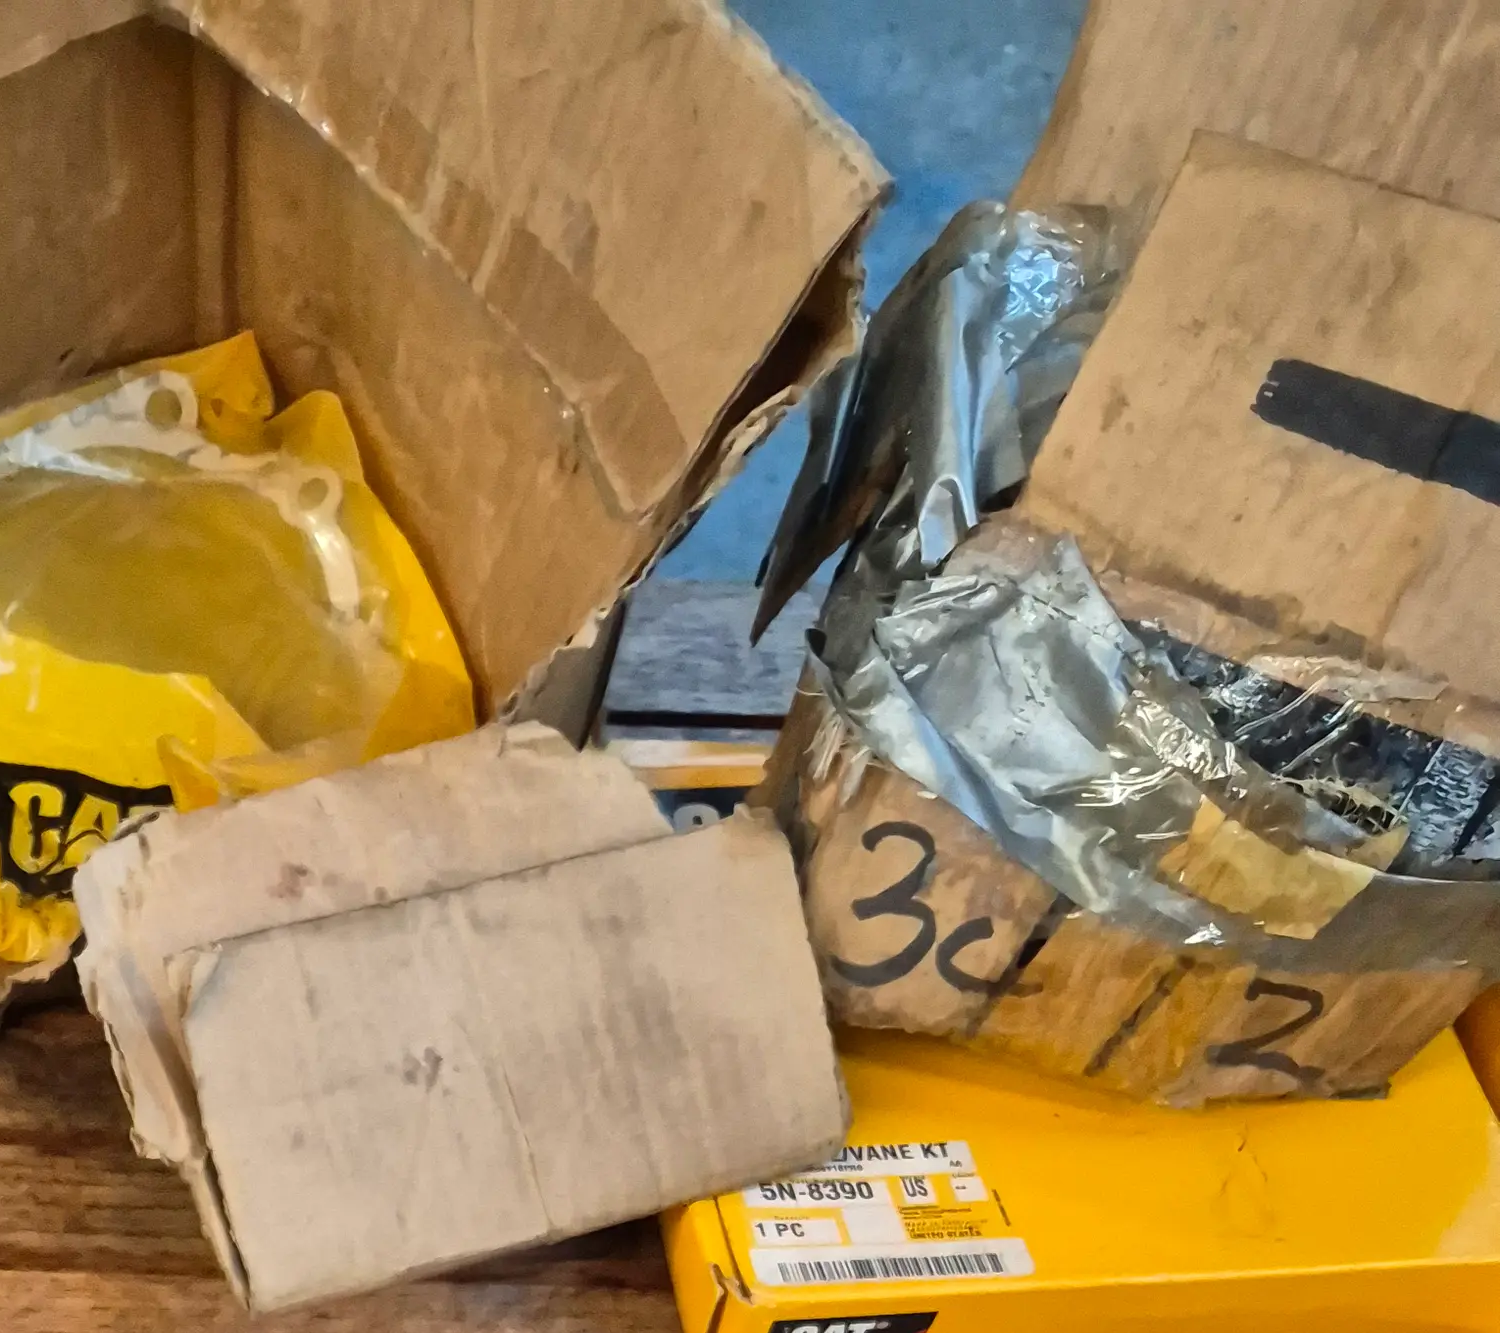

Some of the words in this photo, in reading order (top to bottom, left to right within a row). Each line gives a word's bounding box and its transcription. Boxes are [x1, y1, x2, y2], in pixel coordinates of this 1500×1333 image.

[8, 780, 172, 876] CA
[920, 1142, 949, 1159] KT
[759, 1181, 874, 1201] 5N-8390
[900, 1176, 929, 1198] US
[755, 1223, 767, 1238] 1
[775, 1222, 805, 1238] PC
